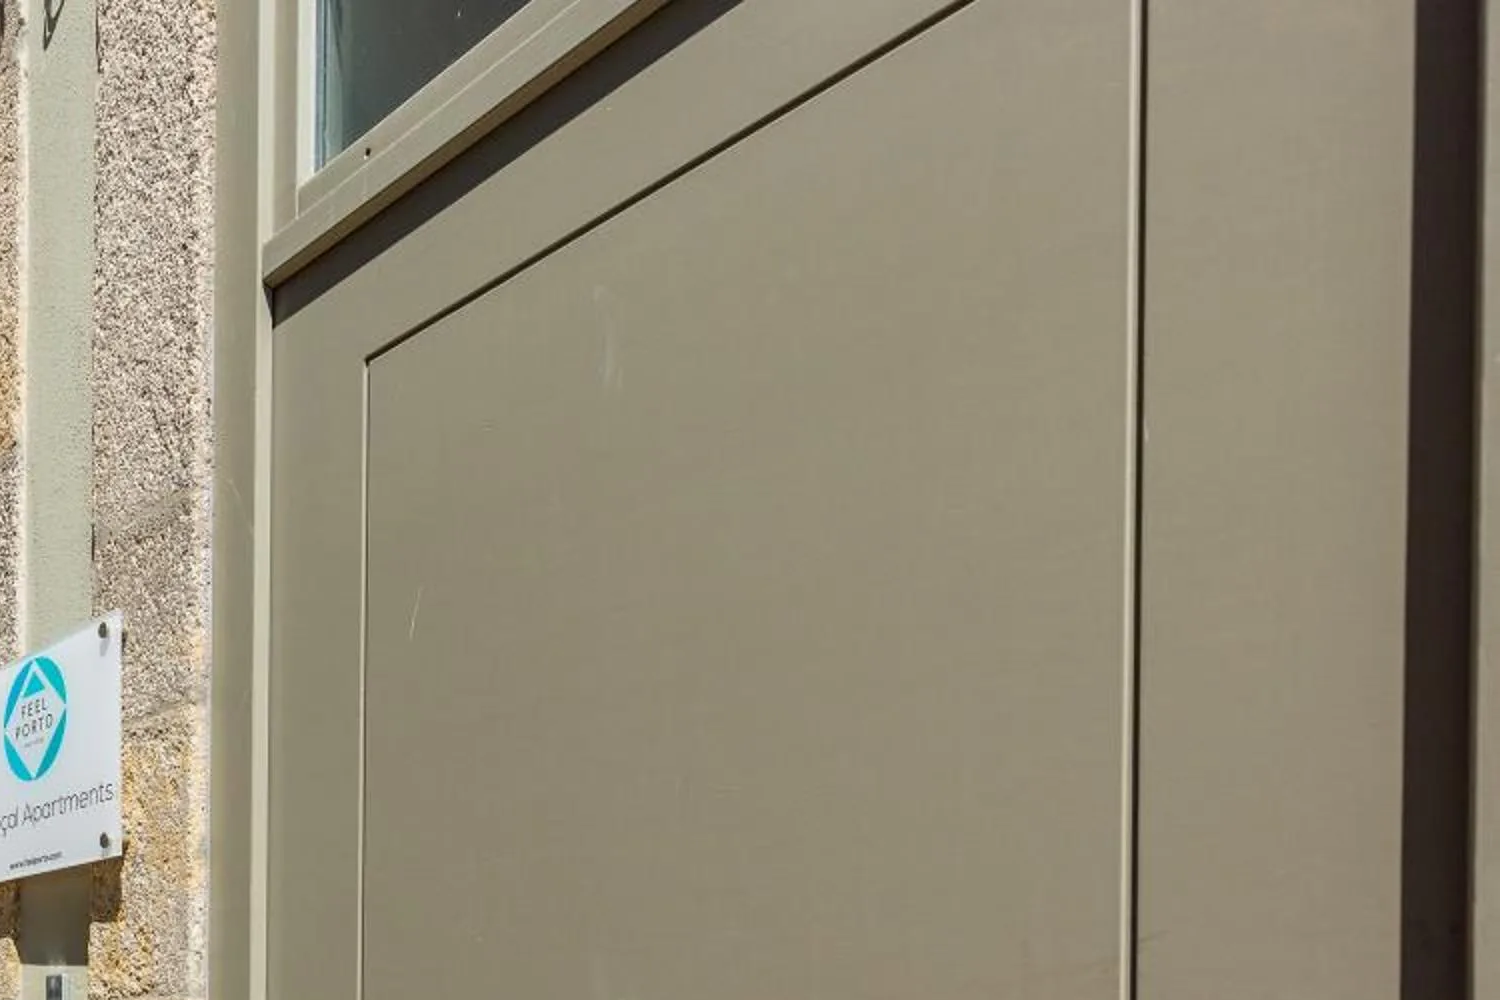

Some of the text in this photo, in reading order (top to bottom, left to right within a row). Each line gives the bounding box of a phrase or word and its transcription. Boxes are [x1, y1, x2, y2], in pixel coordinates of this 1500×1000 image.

[21, 697, 47, 719] FEEL
[15, 713, 53, 740] PORTO
[22, 783, 115, 828] Apartments
